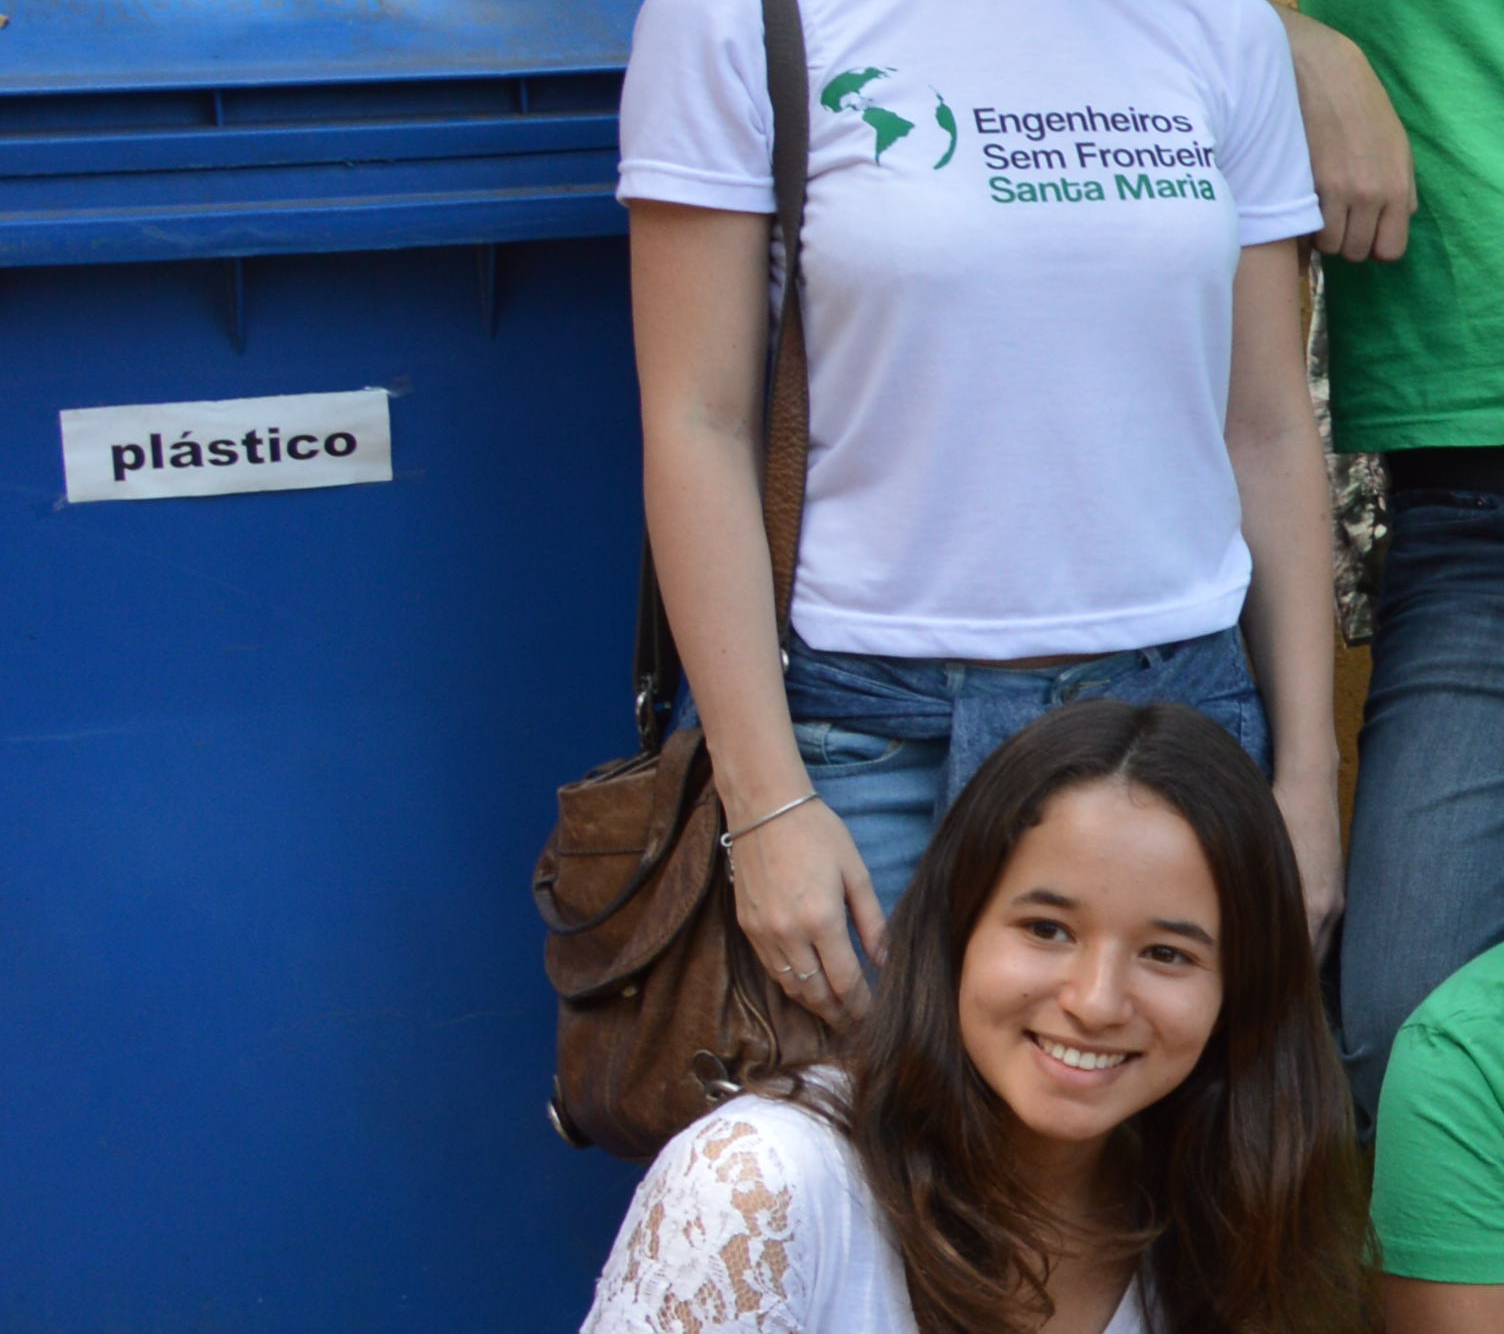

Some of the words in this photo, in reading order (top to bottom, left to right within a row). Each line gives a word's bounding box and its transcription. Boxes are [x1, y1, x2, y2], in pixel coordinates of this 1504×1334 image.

[973, 105, 1192, 141] Engenheiros
[983, 142, 1067, 170] Sem
[988, 174, 1105, 204] Santa
[1114, 173, 1216, 202] Maria
[111, 427, 357, 481] plástico
